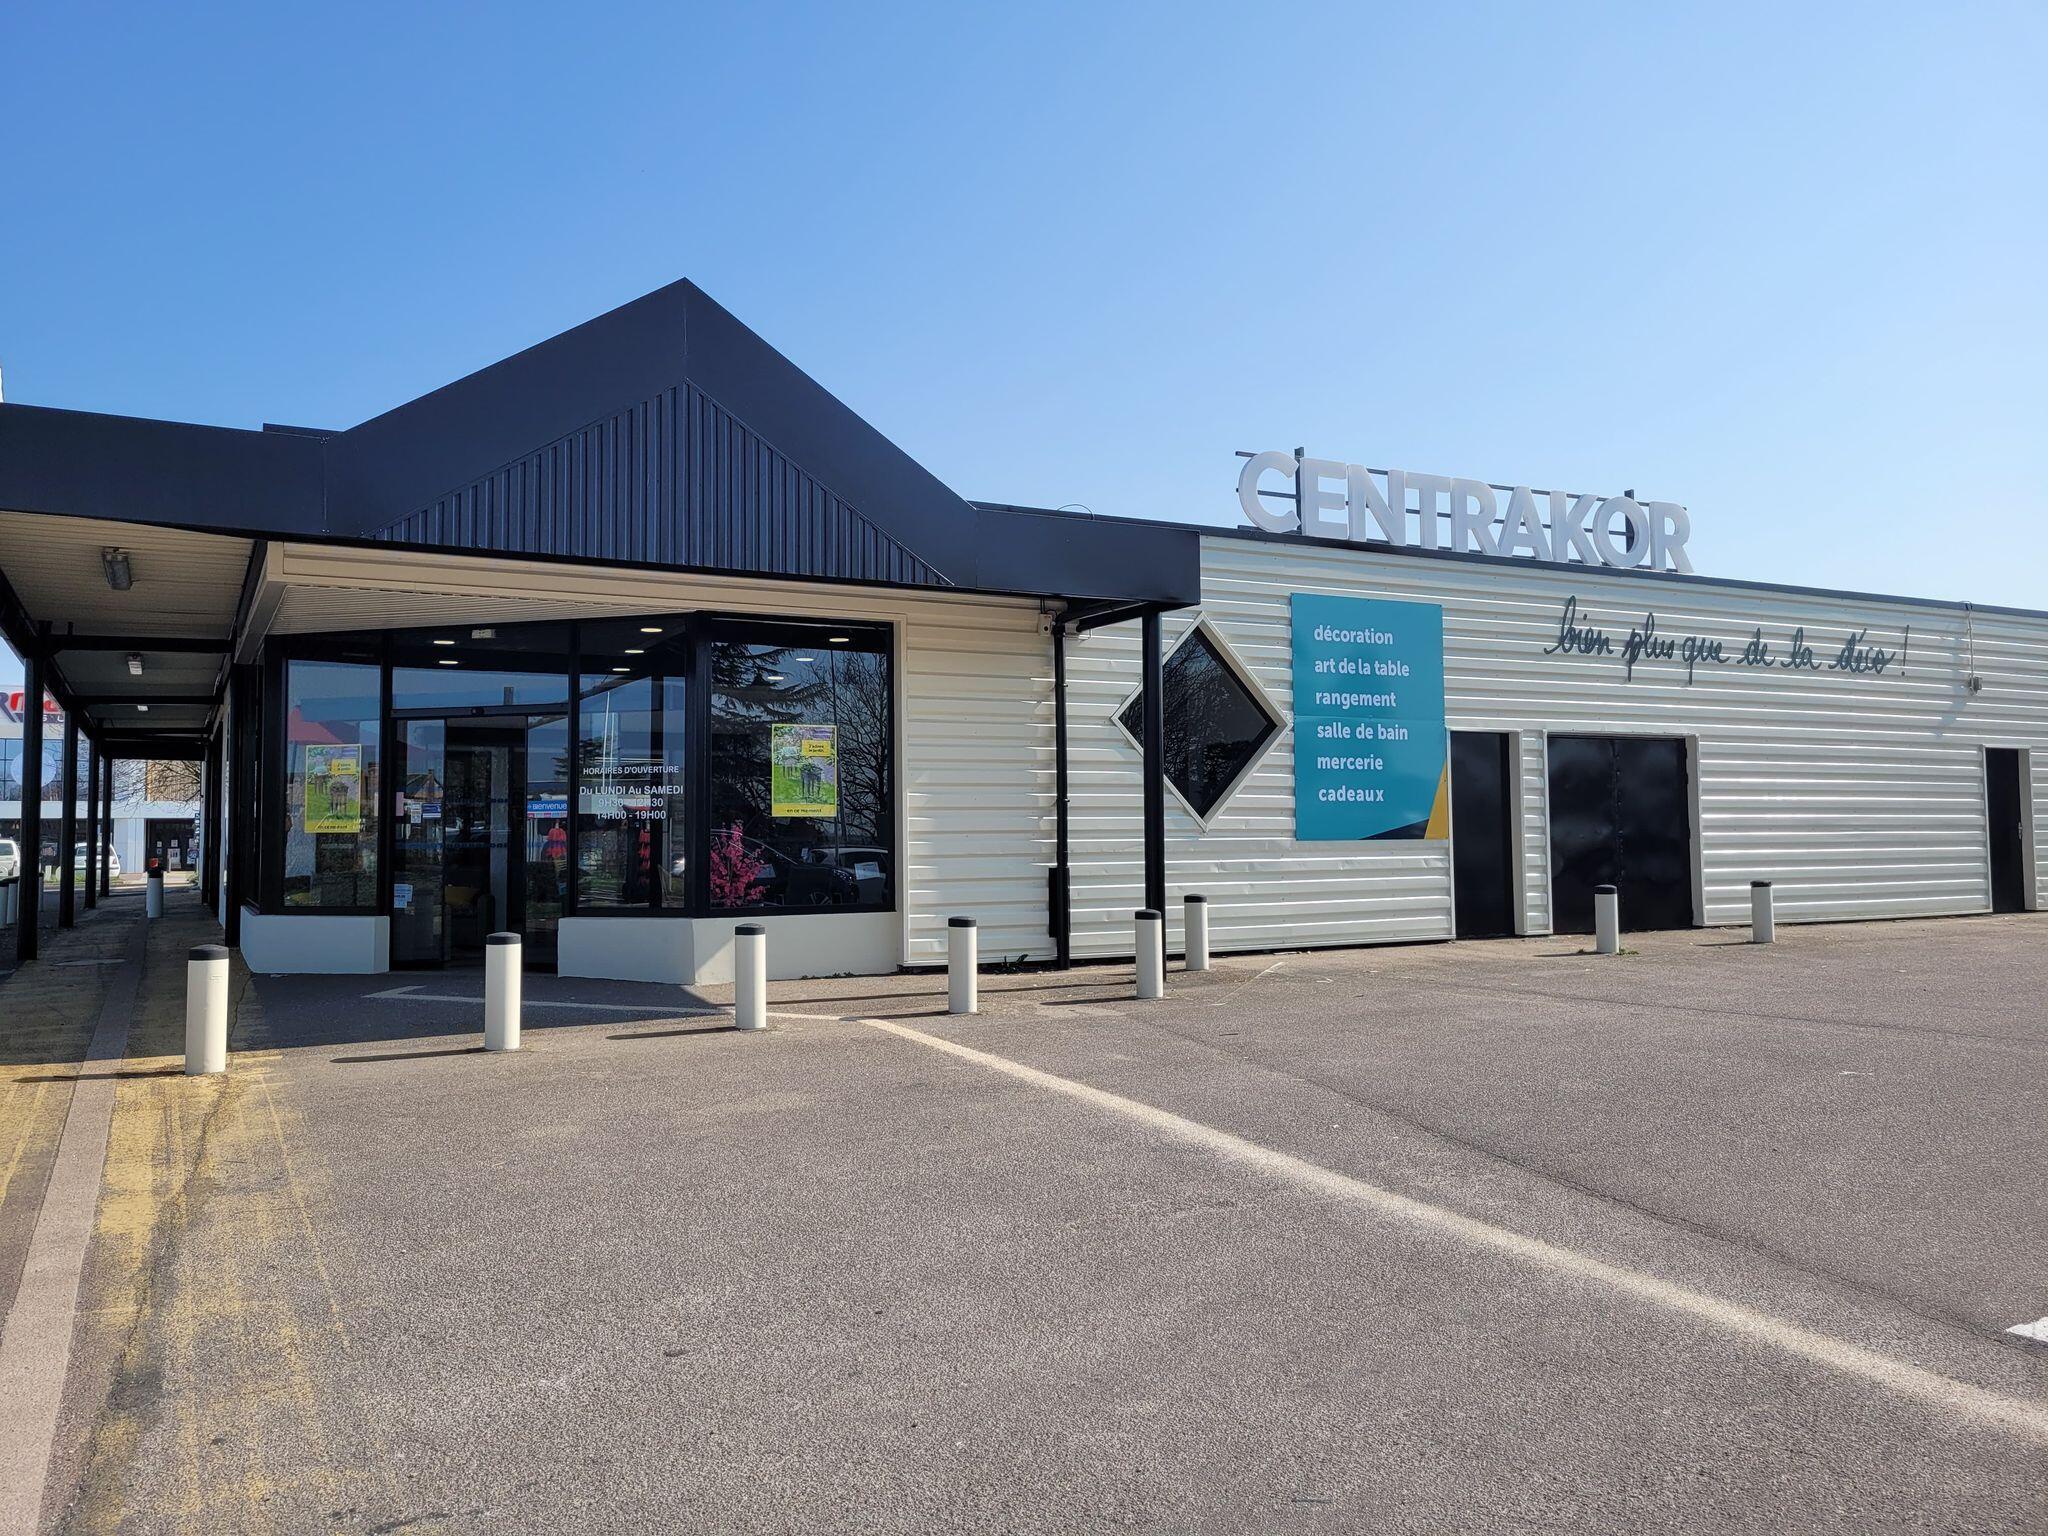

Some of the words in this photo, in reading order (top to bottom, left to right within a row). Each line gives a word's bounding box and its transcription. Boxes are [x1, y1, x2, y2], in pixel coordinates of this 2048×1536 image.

[1238, 450, 1694, 573] CENTRAKOR
[1314, 624, 1394, 645] décoration
[1544, 595, 1613, 655] bien
[1622, 612, 1674, 682] plus
[1681, 635, 1730, 685] que
[1737, 627, 1775, 667] de
[1780, 627, 1822, 671] la
[1314, 659, 1335, 674] art
[1338, 658, 1355, 674] de
[1358, 658, 1371, 675] la
[1374, 660, 1410, 677] table
[1315, 690, 1397, 709] rangement
[1317, 722, 1351, 739] salle
[1356, 723, 1373, 739] de
[1378, 724, 1408, 740] bain
[583, 767, 623, 775] HORAIRES
[624, 766, 679, 774] D'OUVERTURE
[1317, 754, 1383, 770] mercerie
[580, 787, 592, 795] Du
[595, 786, 625, 795] LUNDI
[628, 786, 641, 795] Au
[644, 785, 684, 794] SAMEDI
[1318, 785, 1384, 802] cadeaux
[599, 798, 624, 807] 9H30
[597, 810, 627, 819] 14H00
[635, 810, 667, 819] 19H00
